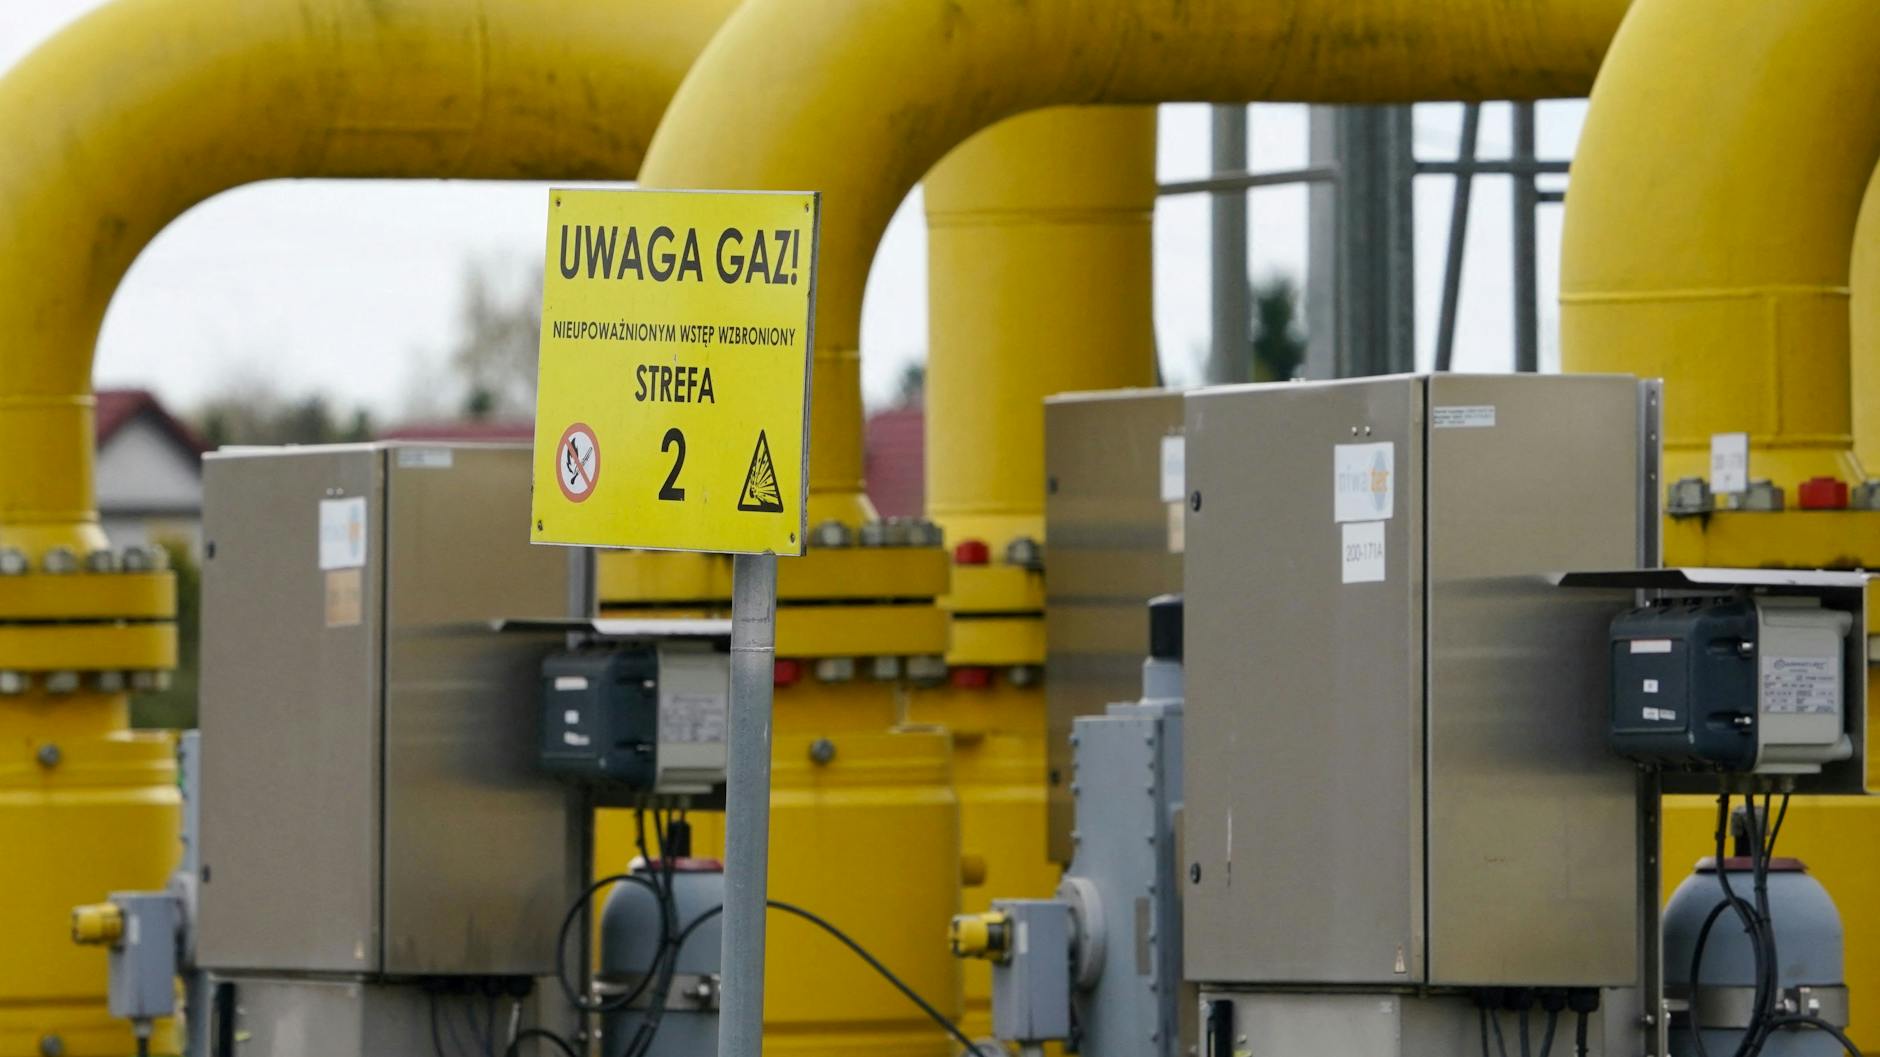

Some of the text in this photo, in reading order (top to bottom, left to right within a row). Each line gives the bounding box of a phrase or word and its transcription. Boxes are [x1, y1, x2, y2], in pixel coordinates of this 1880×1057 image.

[560, 224, 800, 286] UWAGA GAZ!
[552, 318, 796, 348] NIEUPOWAŻNIONYM WSTĘP WZBRONIONY
[634, 364, 716, 405] STREFA
[658, 427, 687, 502] 2
